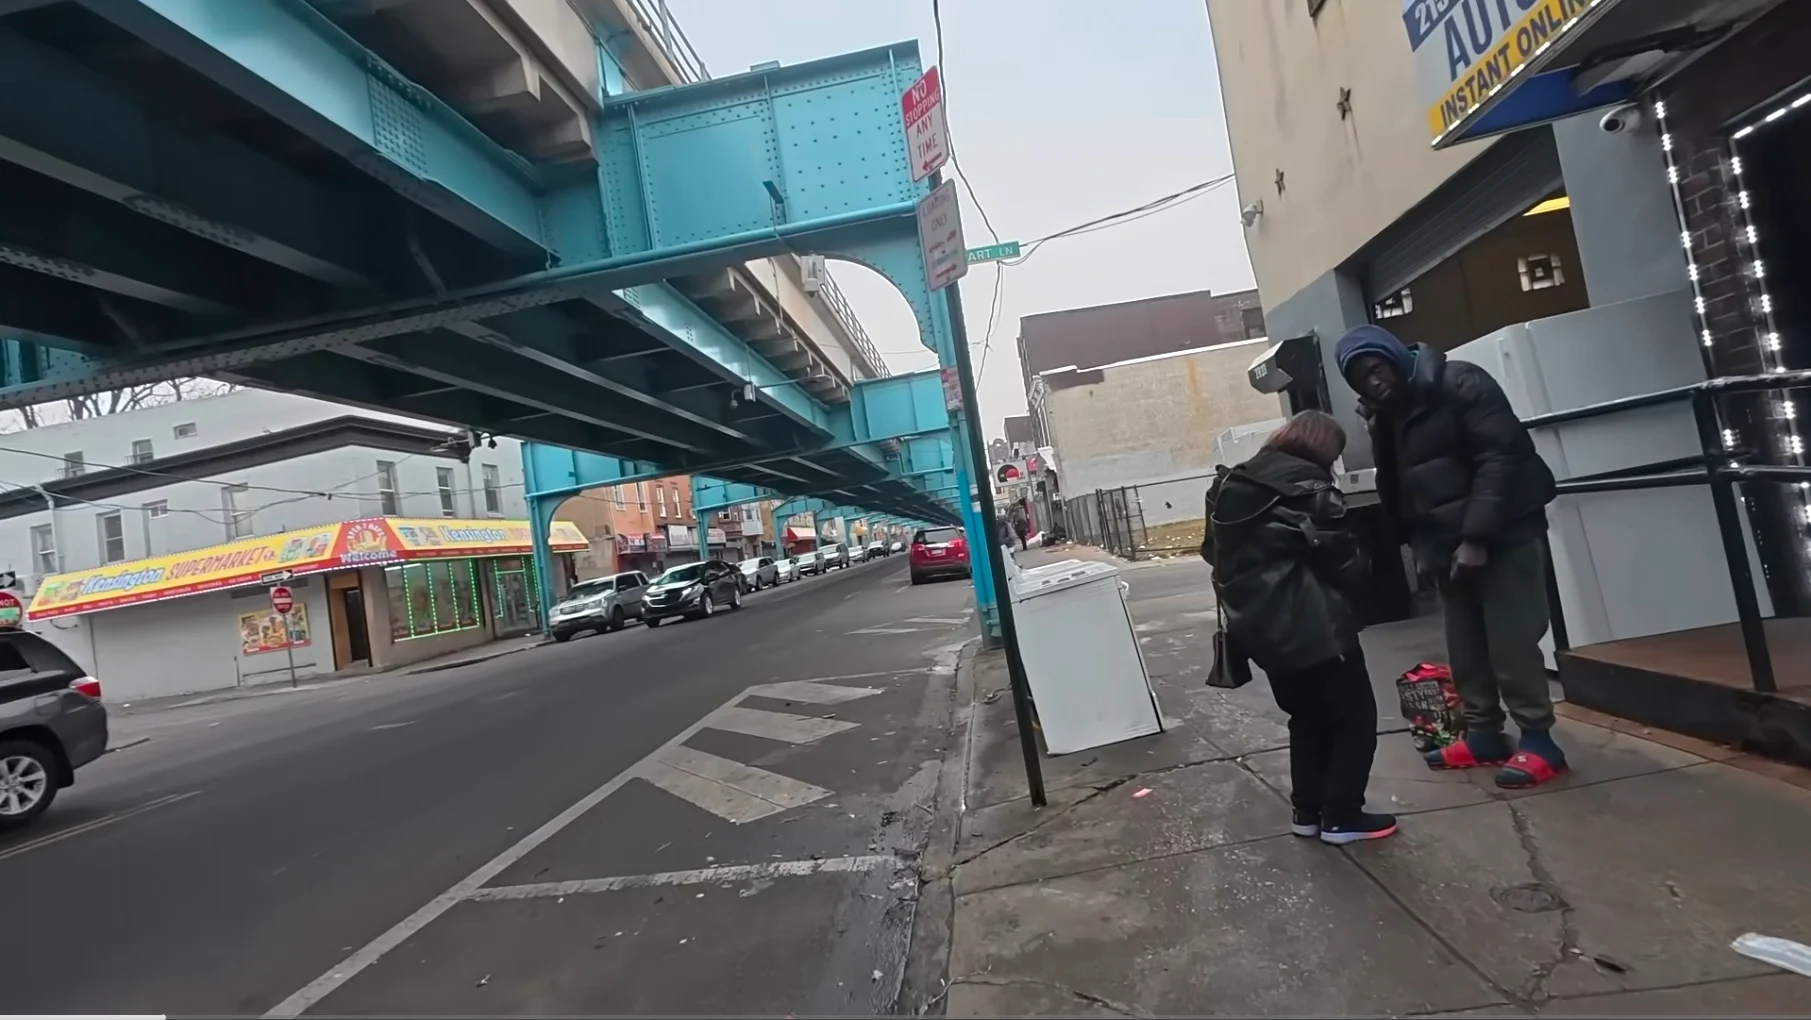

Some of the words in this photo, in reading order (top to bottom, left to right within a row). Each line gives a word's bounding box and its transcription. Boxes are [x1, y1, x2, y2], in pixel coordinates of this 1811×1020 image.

[912, 79, 927, 105] NO
[1440, 43, 1510, 128] INSTANT
[905, 87, 940, 127] STOPPING
[916, 112, 933, 139] ANY
[918, 132, 938, 159] TIME
[998, 246, 1014, 256] LN
[439, 525, 508, 544] Kensington
[340, 550, 397, 563] Welcome
[82, 566, 165, 595] Kensington
[166, 546, 269, 580] SUPERMARKET
